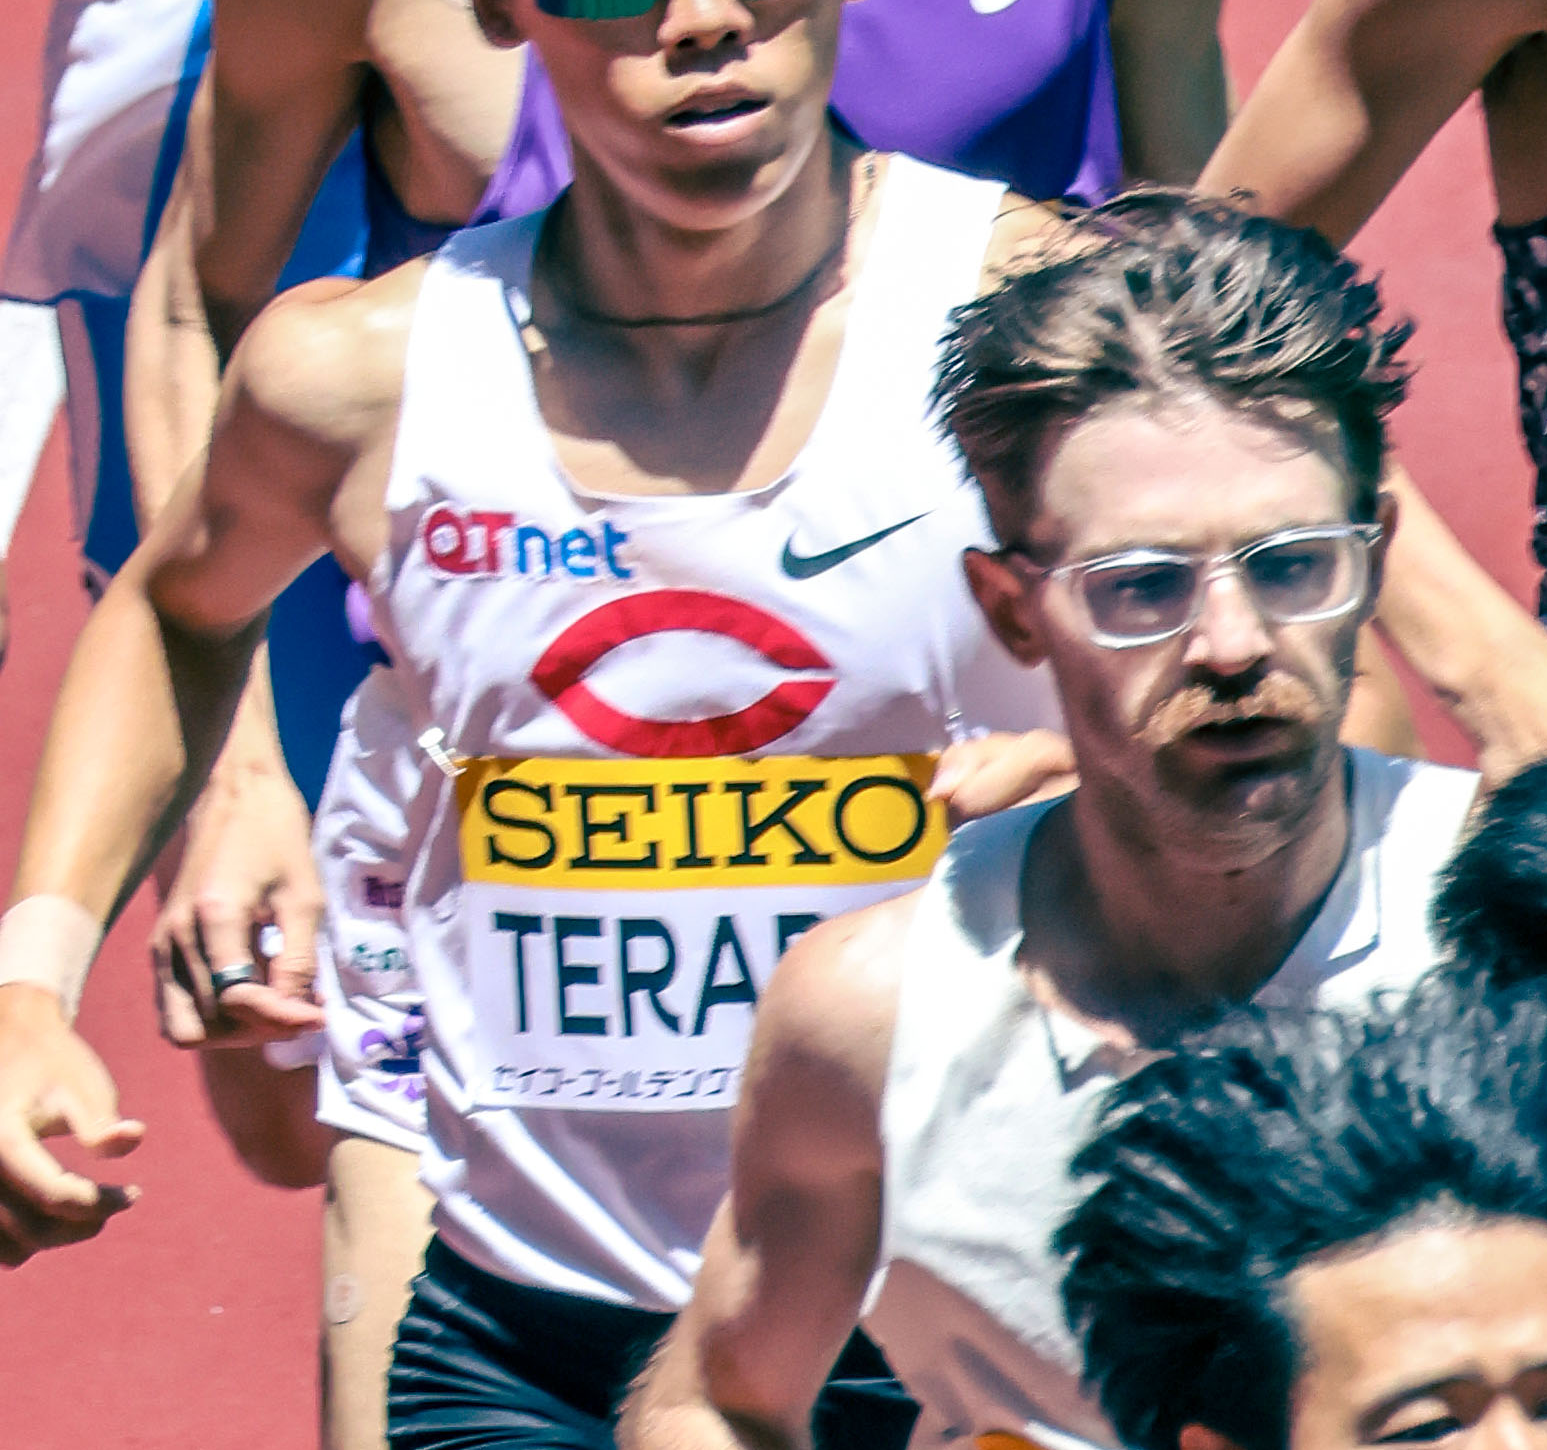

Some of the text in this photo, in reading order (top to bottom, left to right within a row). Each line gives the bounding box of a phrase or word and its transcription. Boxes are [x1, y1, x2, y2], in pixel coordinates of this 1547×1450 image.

[421, 507, 636, 581] QTnet
[482, 775, 928, 872] SEIKO
[491, 912, 827, 1038] TERA
